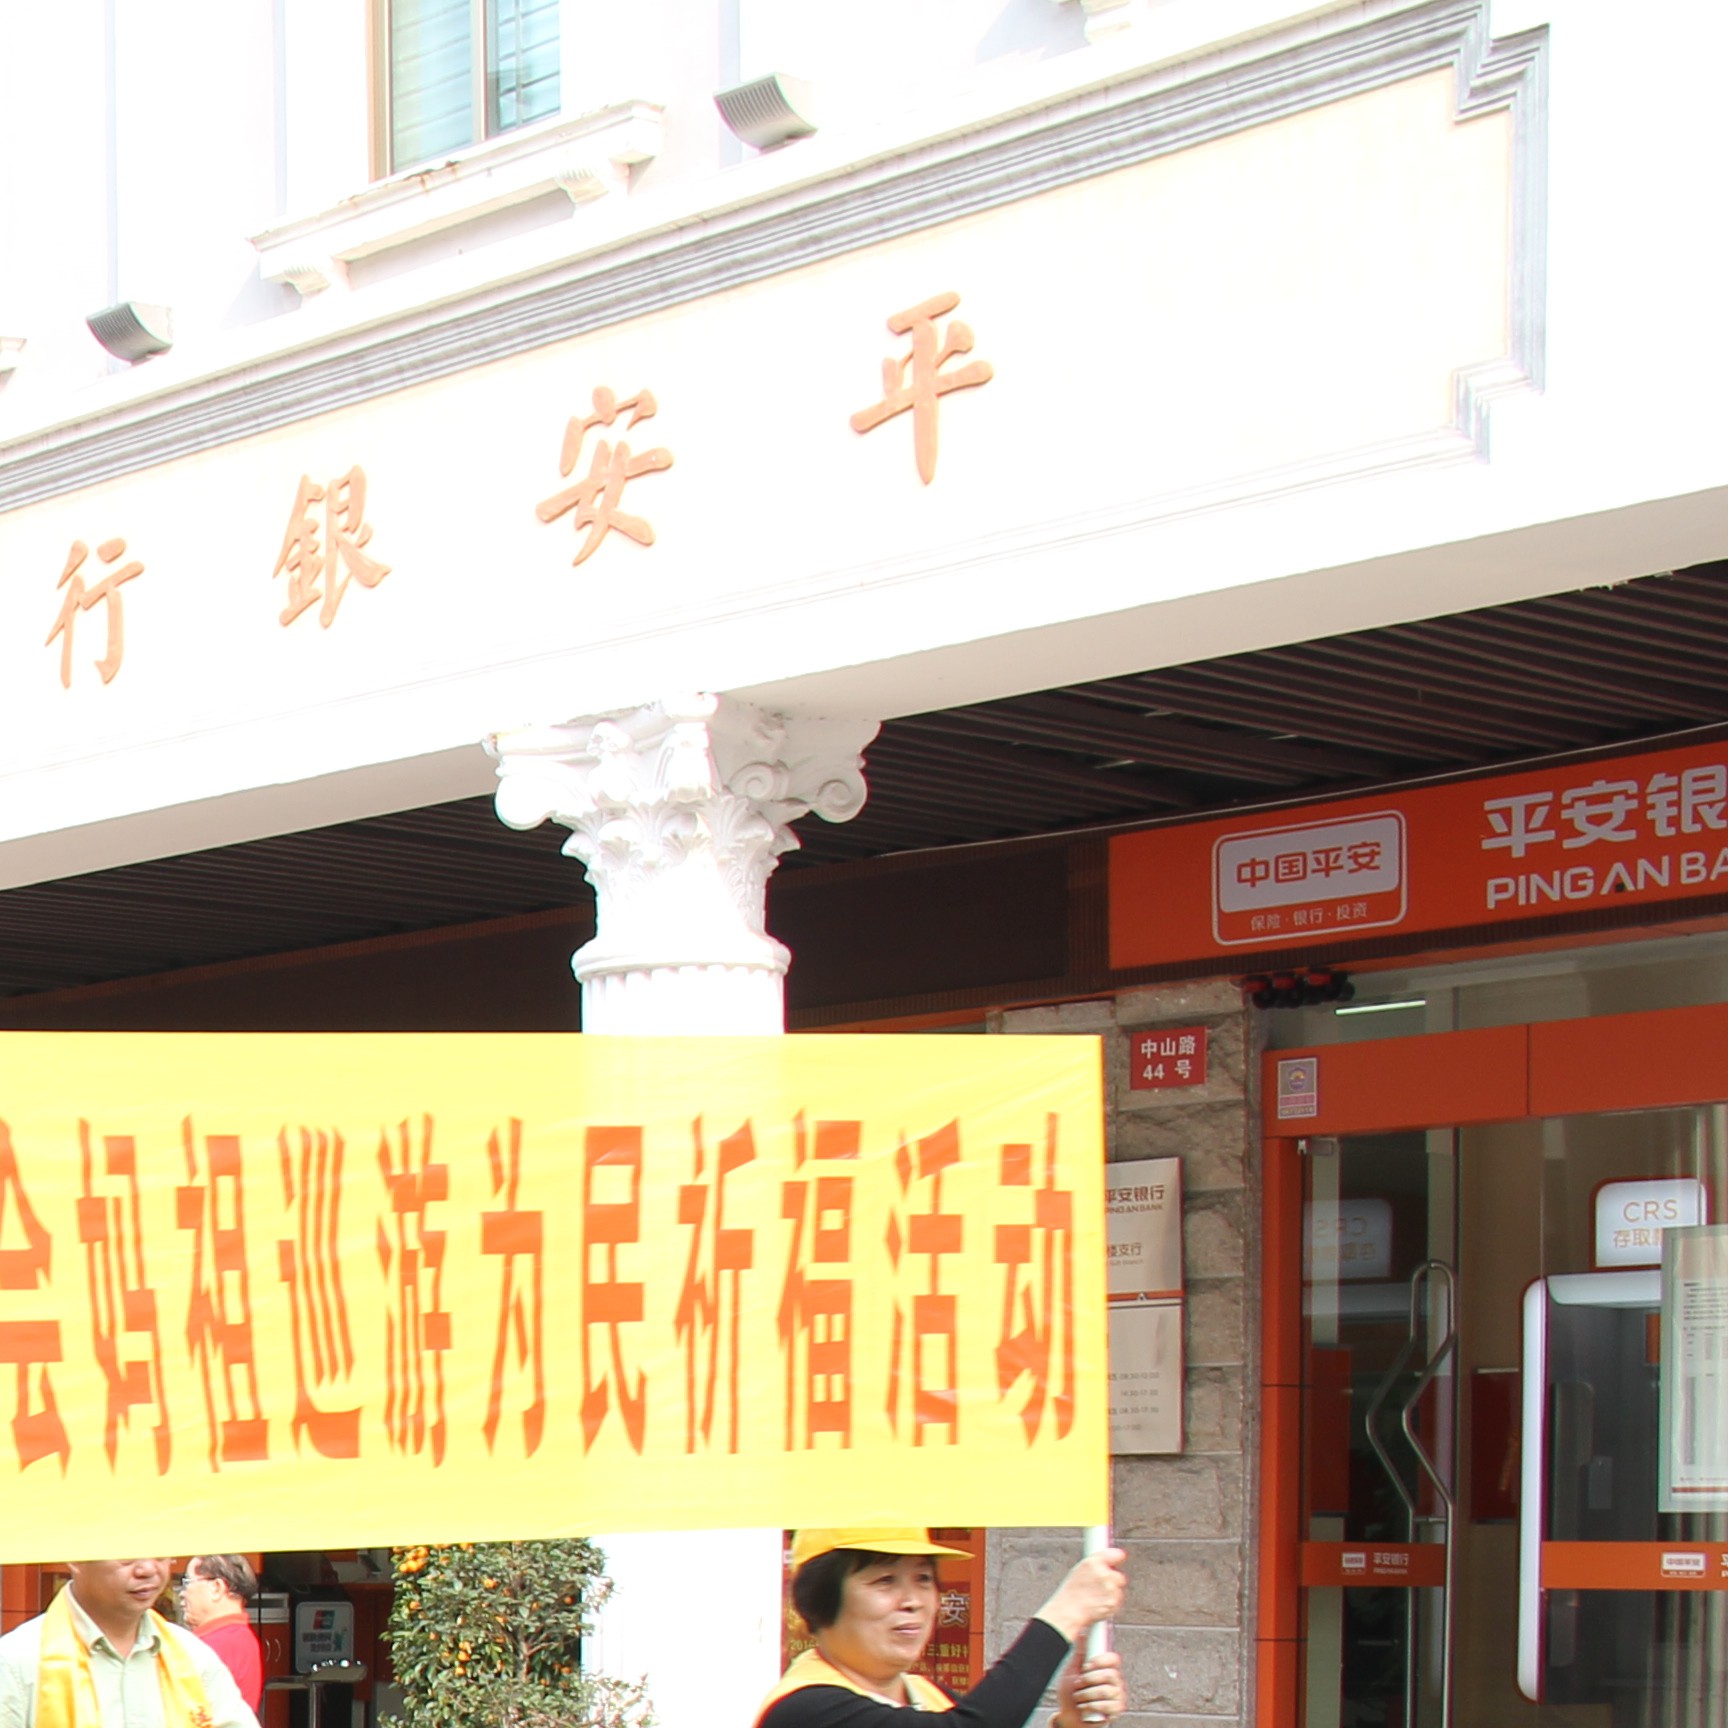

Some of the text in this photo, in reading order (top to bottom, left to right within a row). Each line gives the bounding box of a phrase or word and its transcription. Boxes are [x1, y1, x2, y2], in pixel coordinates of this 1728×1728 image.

[1480, 764, 1728, 859] 平安银
[1236, 841, 1382, 888] 中国平安
[1141, 1035, 1197, 1060] 中山路
[1142, 1059, 1193, 1081] 44 号
[1623, 1199, 1679, 1223] CRS
[940, 1593, 966, 1625] 安
